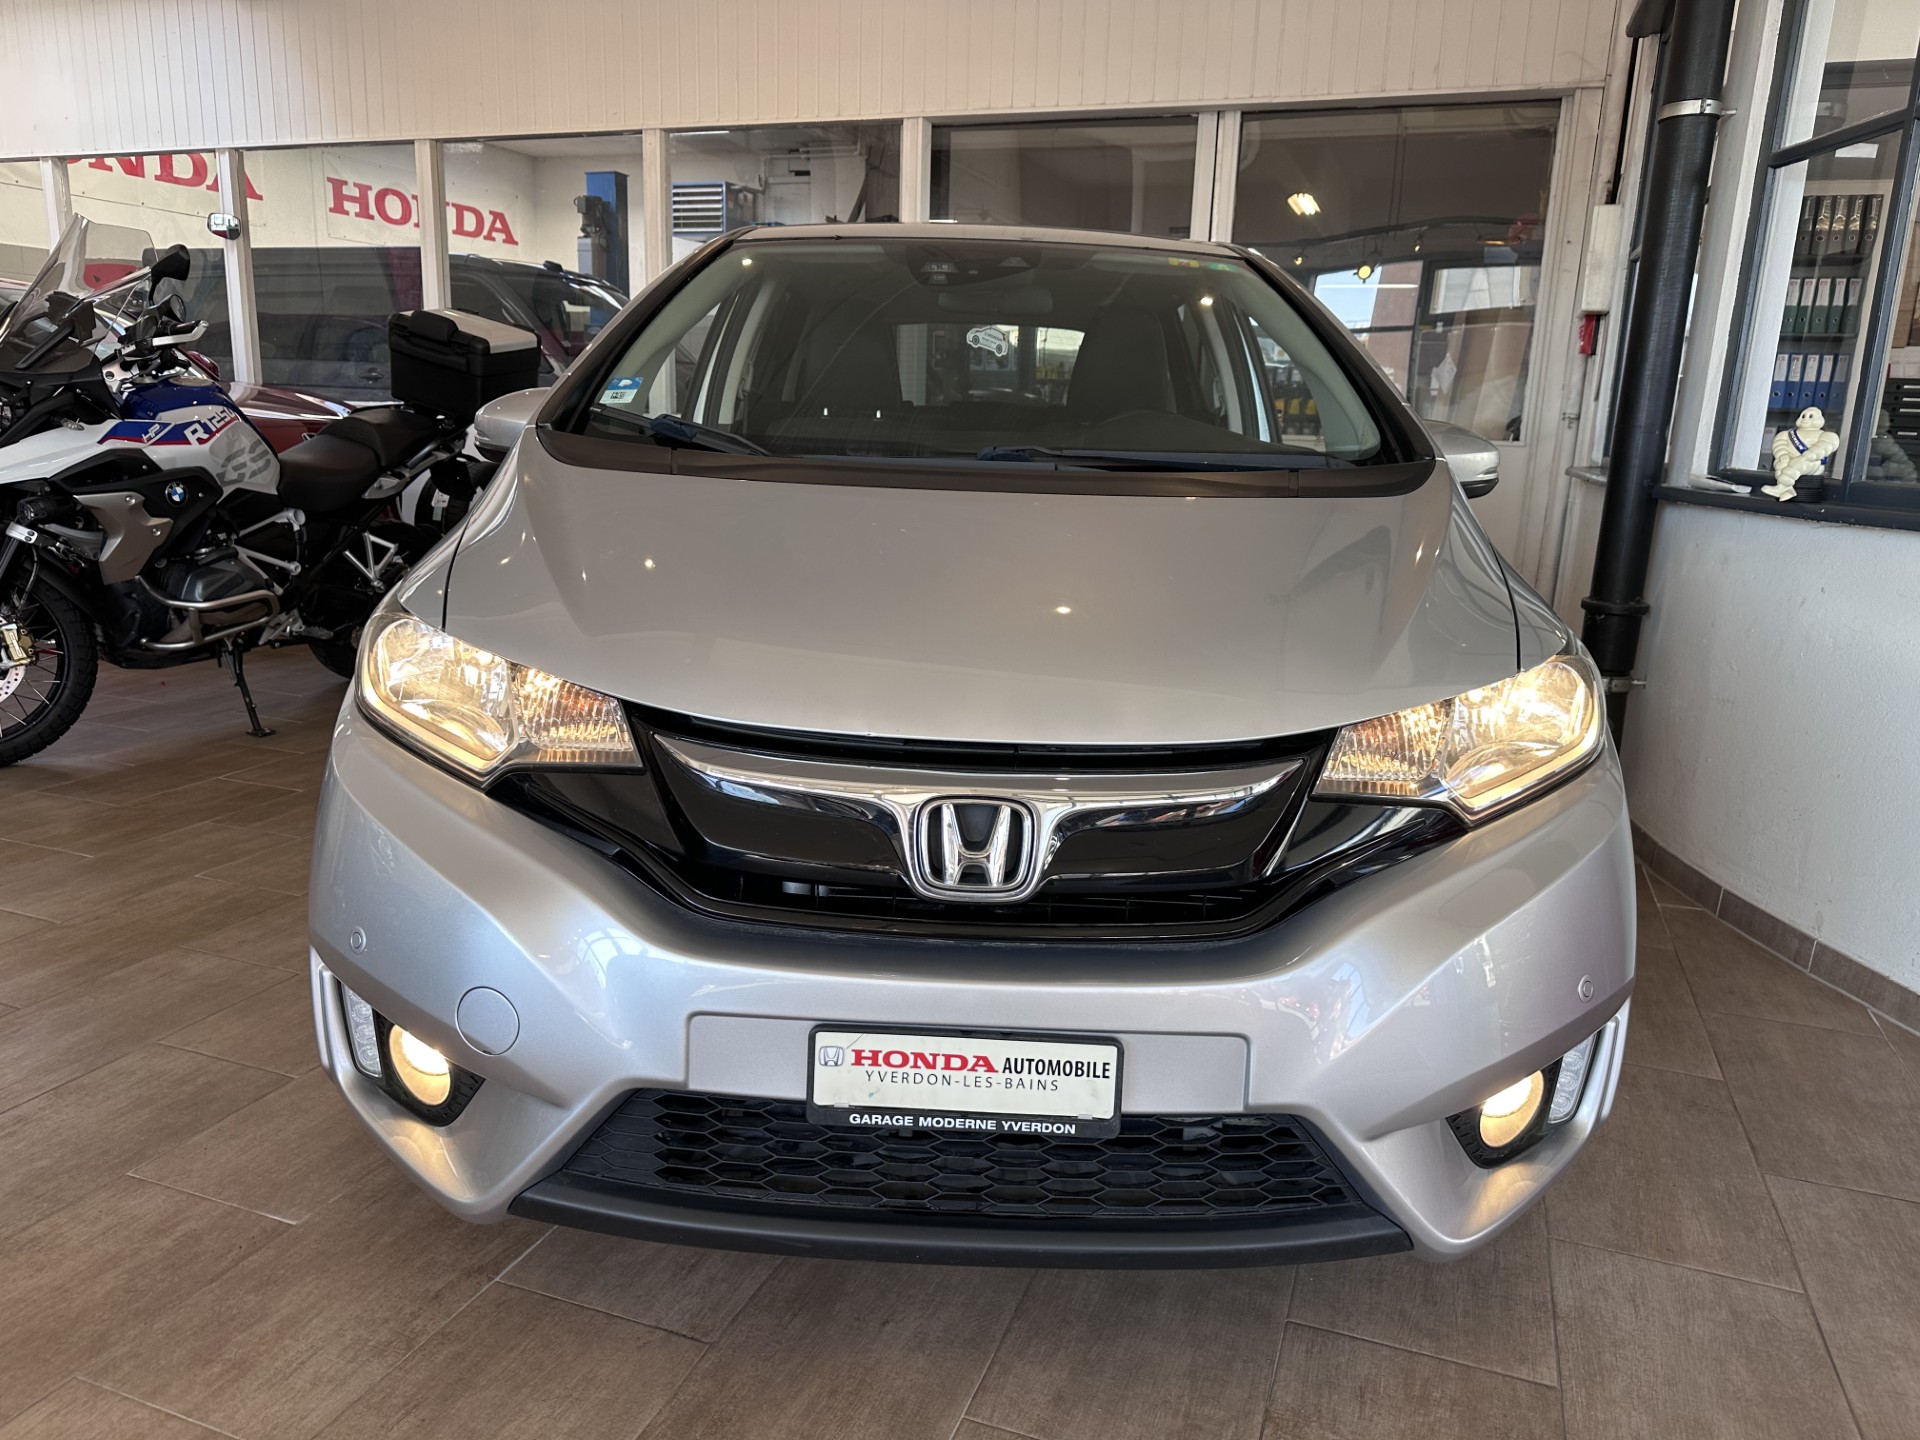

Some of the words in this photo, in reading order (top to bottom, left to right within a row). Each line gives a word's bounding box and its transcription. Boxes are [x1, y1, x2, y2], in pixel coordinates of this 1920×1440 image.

[326, 177, 519, 246] HODA
[851, 1049, 998, 1073] HONDA
[1002, 1057, 1110, 1079] AUTOMOBILE
[866, 1070, 1058, 1091] YVERDON-LES-BAINS
[849, 1113, 914, 1126] GARAGE
[918, 1116, 997, 1131] MODERNE
[1001, 1120, 1076, 1135] YVERDON
